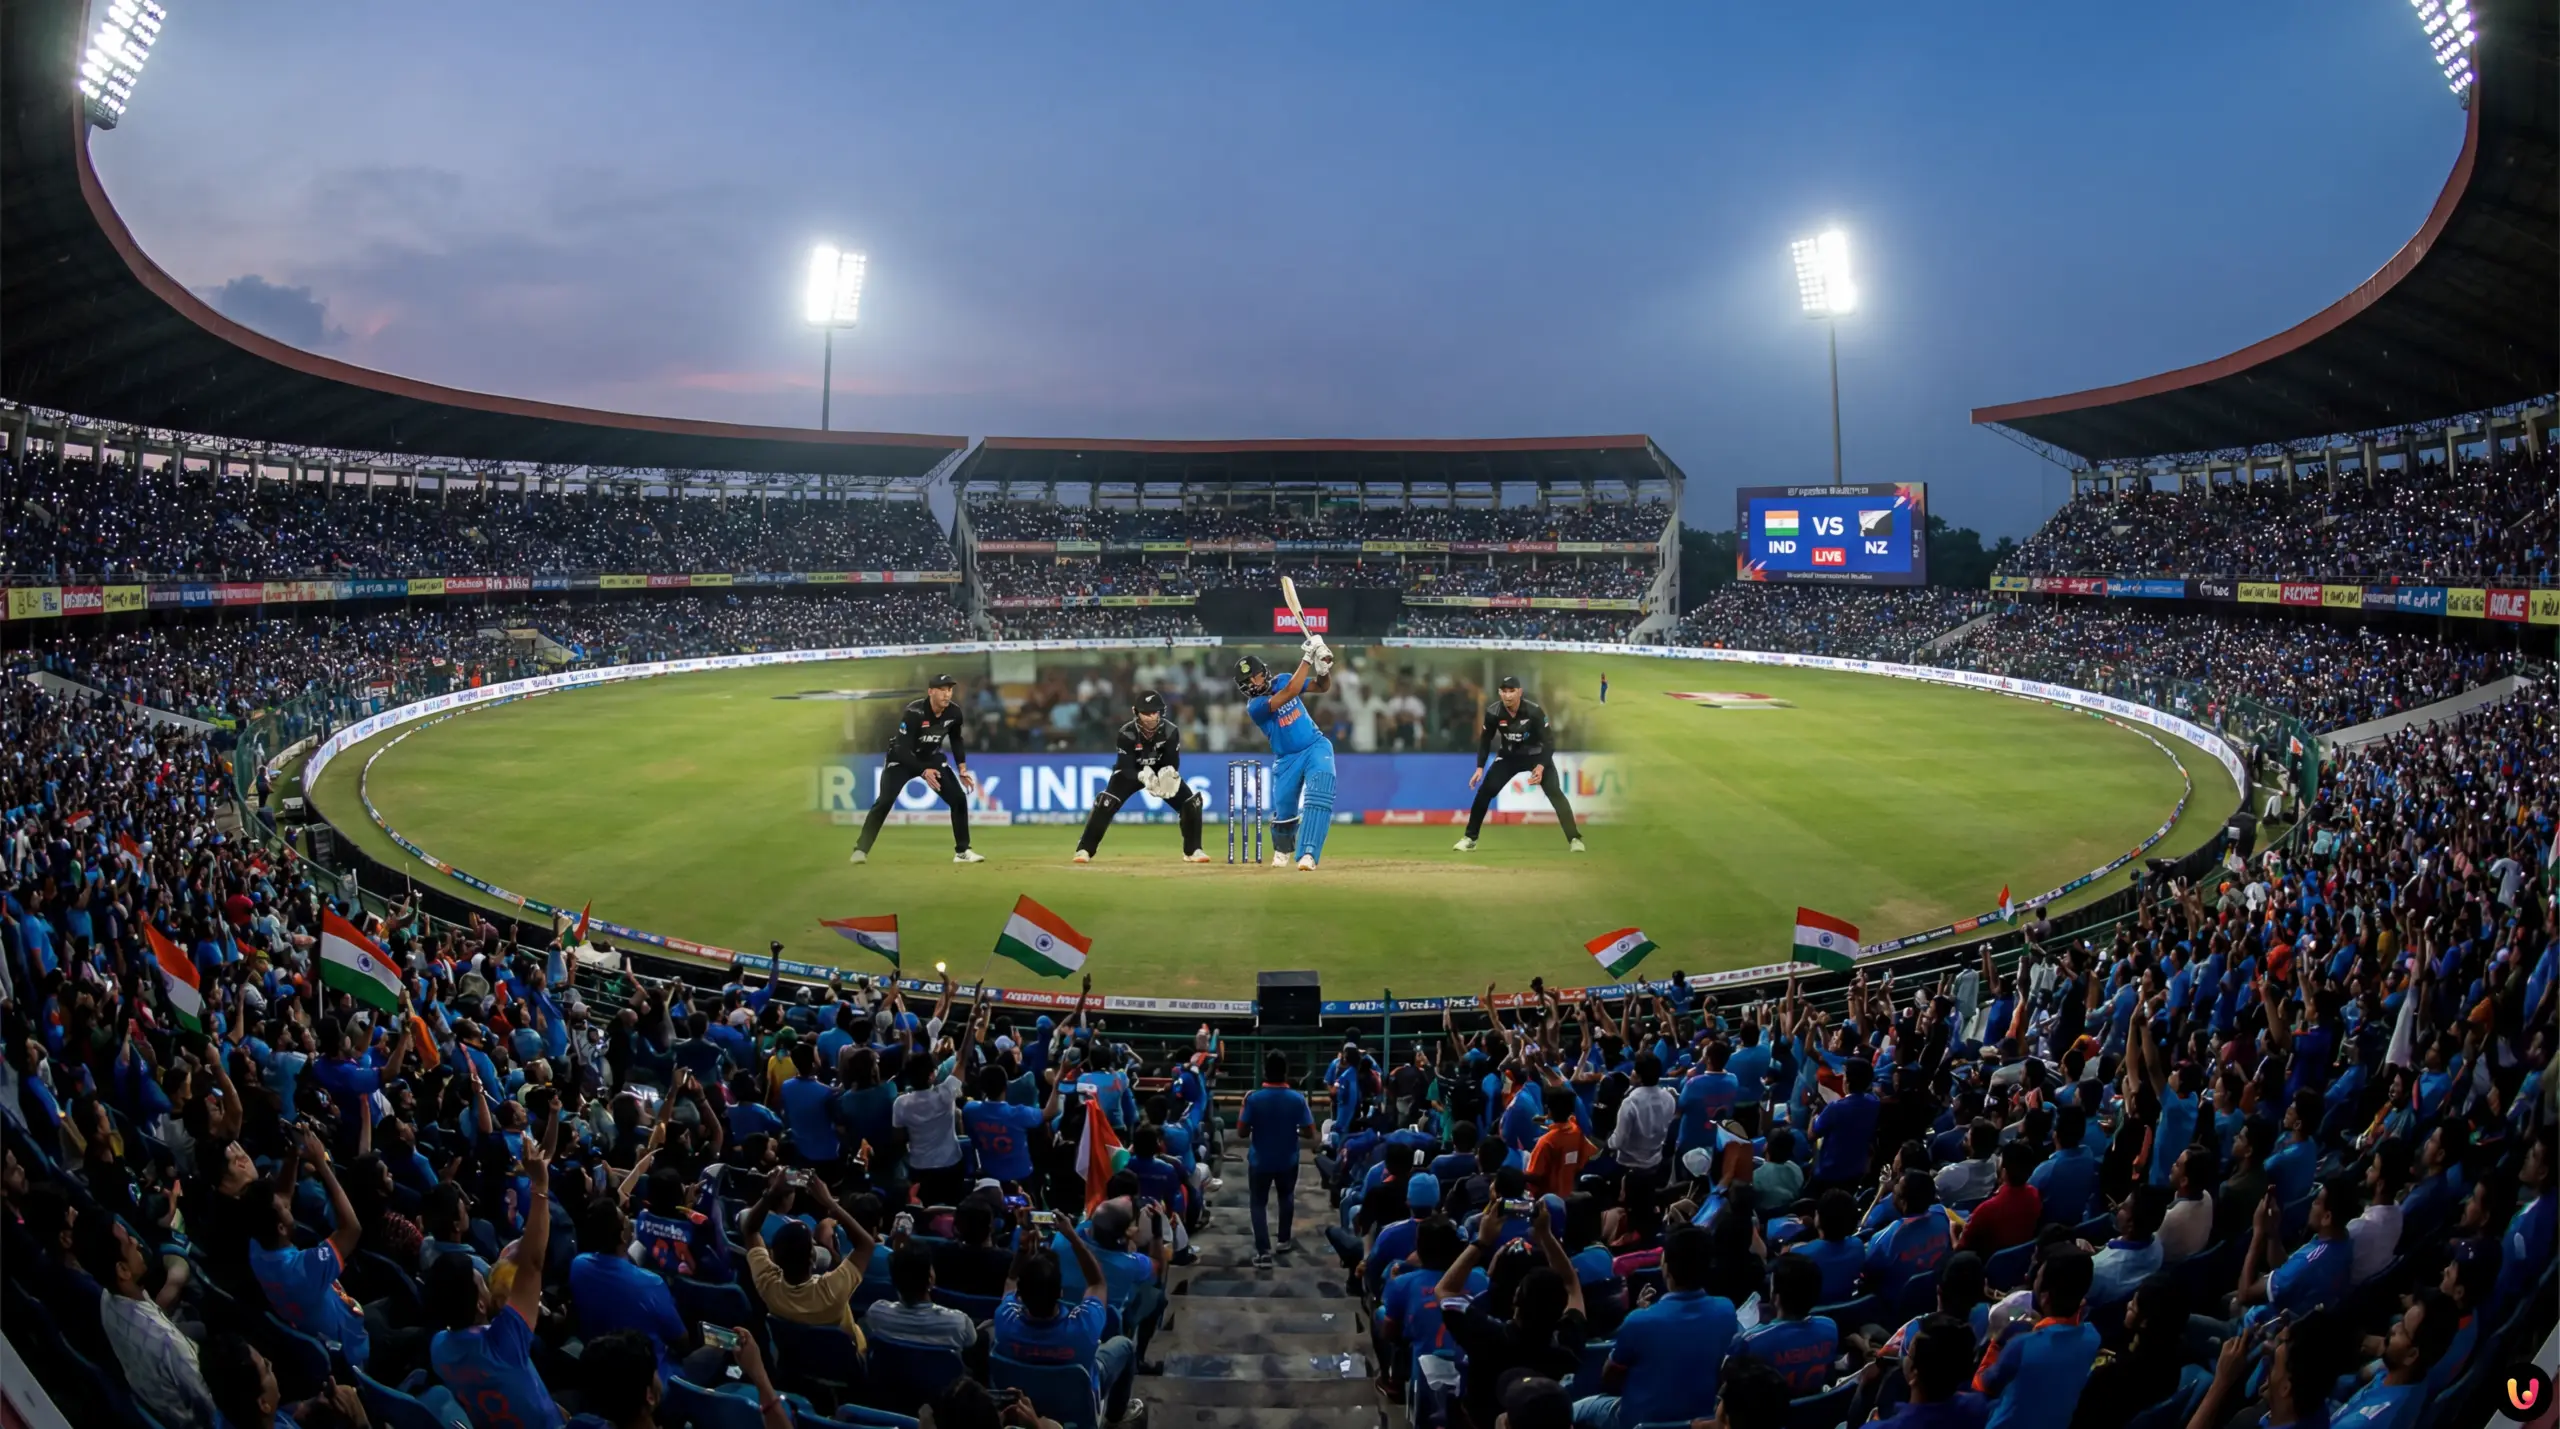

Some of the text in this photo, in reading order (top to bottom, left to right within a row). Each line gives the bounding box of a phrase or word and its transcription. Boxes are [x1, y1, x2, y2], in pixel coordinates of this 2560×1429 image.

[1812, 516, 1844, 536] VS
[1768, 541, 1797, 554] IND
[1865, 541, 1889, 554] NZ
[1815, 551, 1843, 563] LIVE
[1020, 766, 1113, 810] IND
